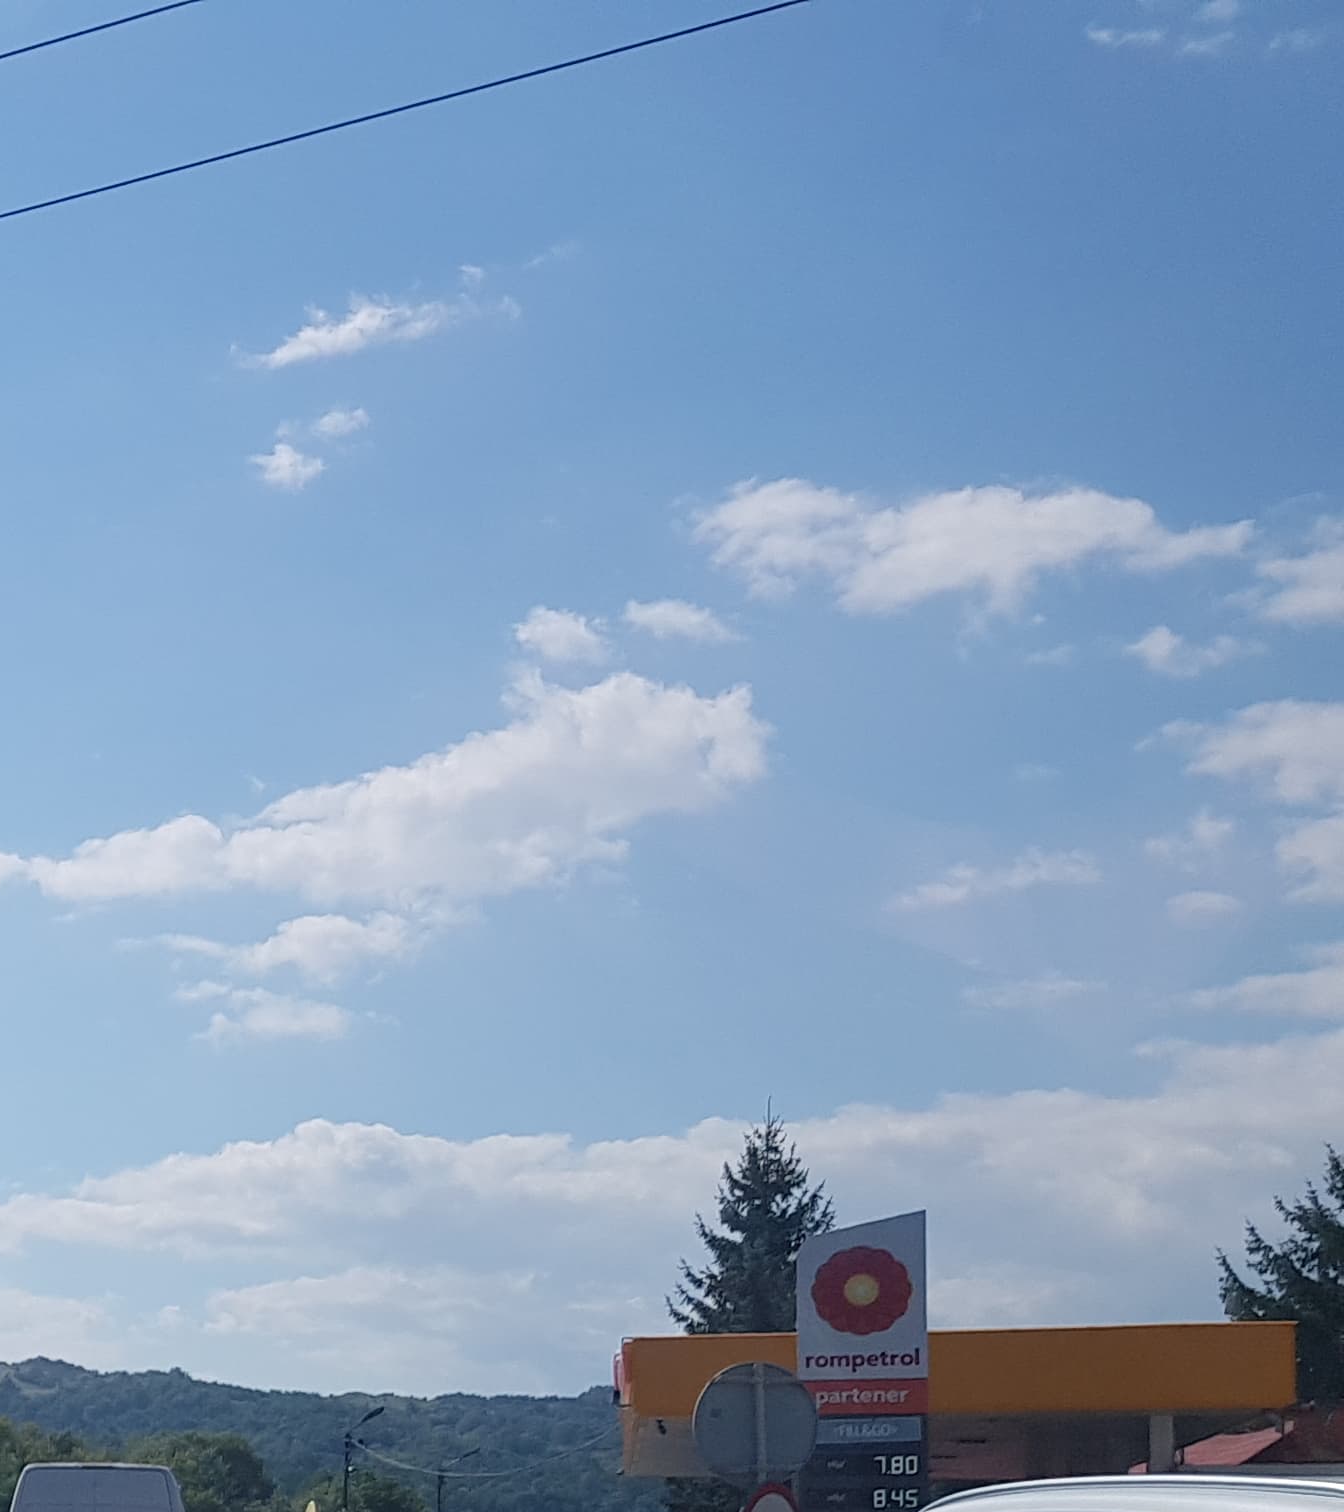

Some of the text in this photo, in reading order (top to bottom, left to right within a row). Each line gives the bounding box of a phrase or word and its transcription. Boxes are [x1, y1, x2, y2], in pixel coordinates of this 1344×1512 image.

[804, 1348, 920, 1373] rompetrol
[815, 1387, 909, 1411] partener
[873, 1455, 918, 1475] 7.80
[873, 1488, 919, 1509] 8.45
